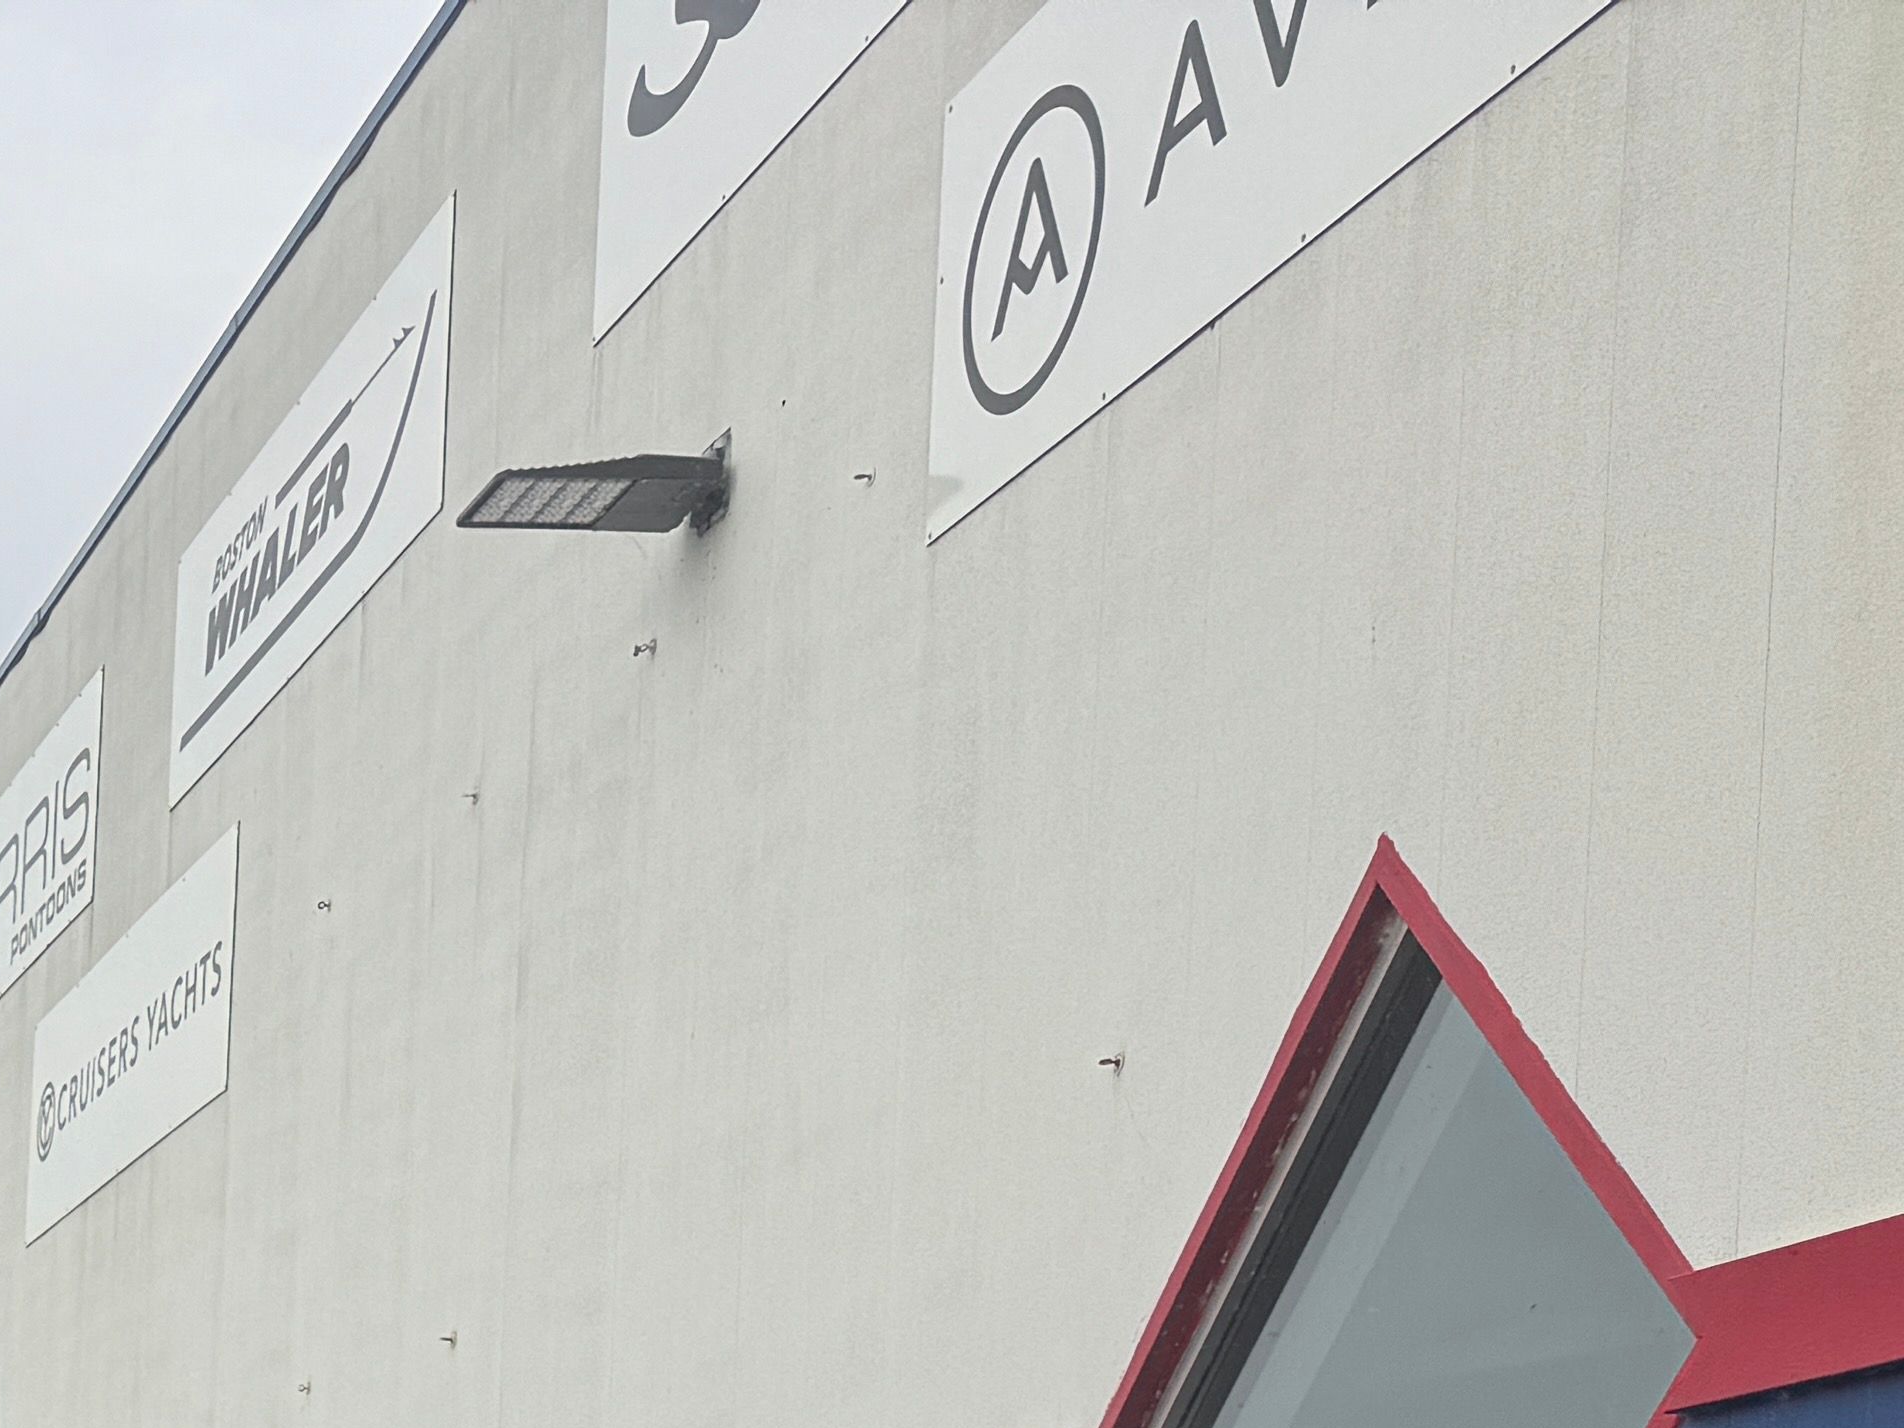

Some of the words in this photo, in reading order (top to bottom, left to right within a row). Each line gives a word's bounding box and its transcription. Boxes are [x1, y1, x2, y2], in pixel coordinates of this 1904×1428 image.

[205, 442, 350, 677] WHALER
[212, 496, 268, 594] BOSTON
[10, 858, 87, 966] PONTOONS
[57, 1015, 140, 1131] CRUISERS
[147, 941, 223, 1051] YACHTS
